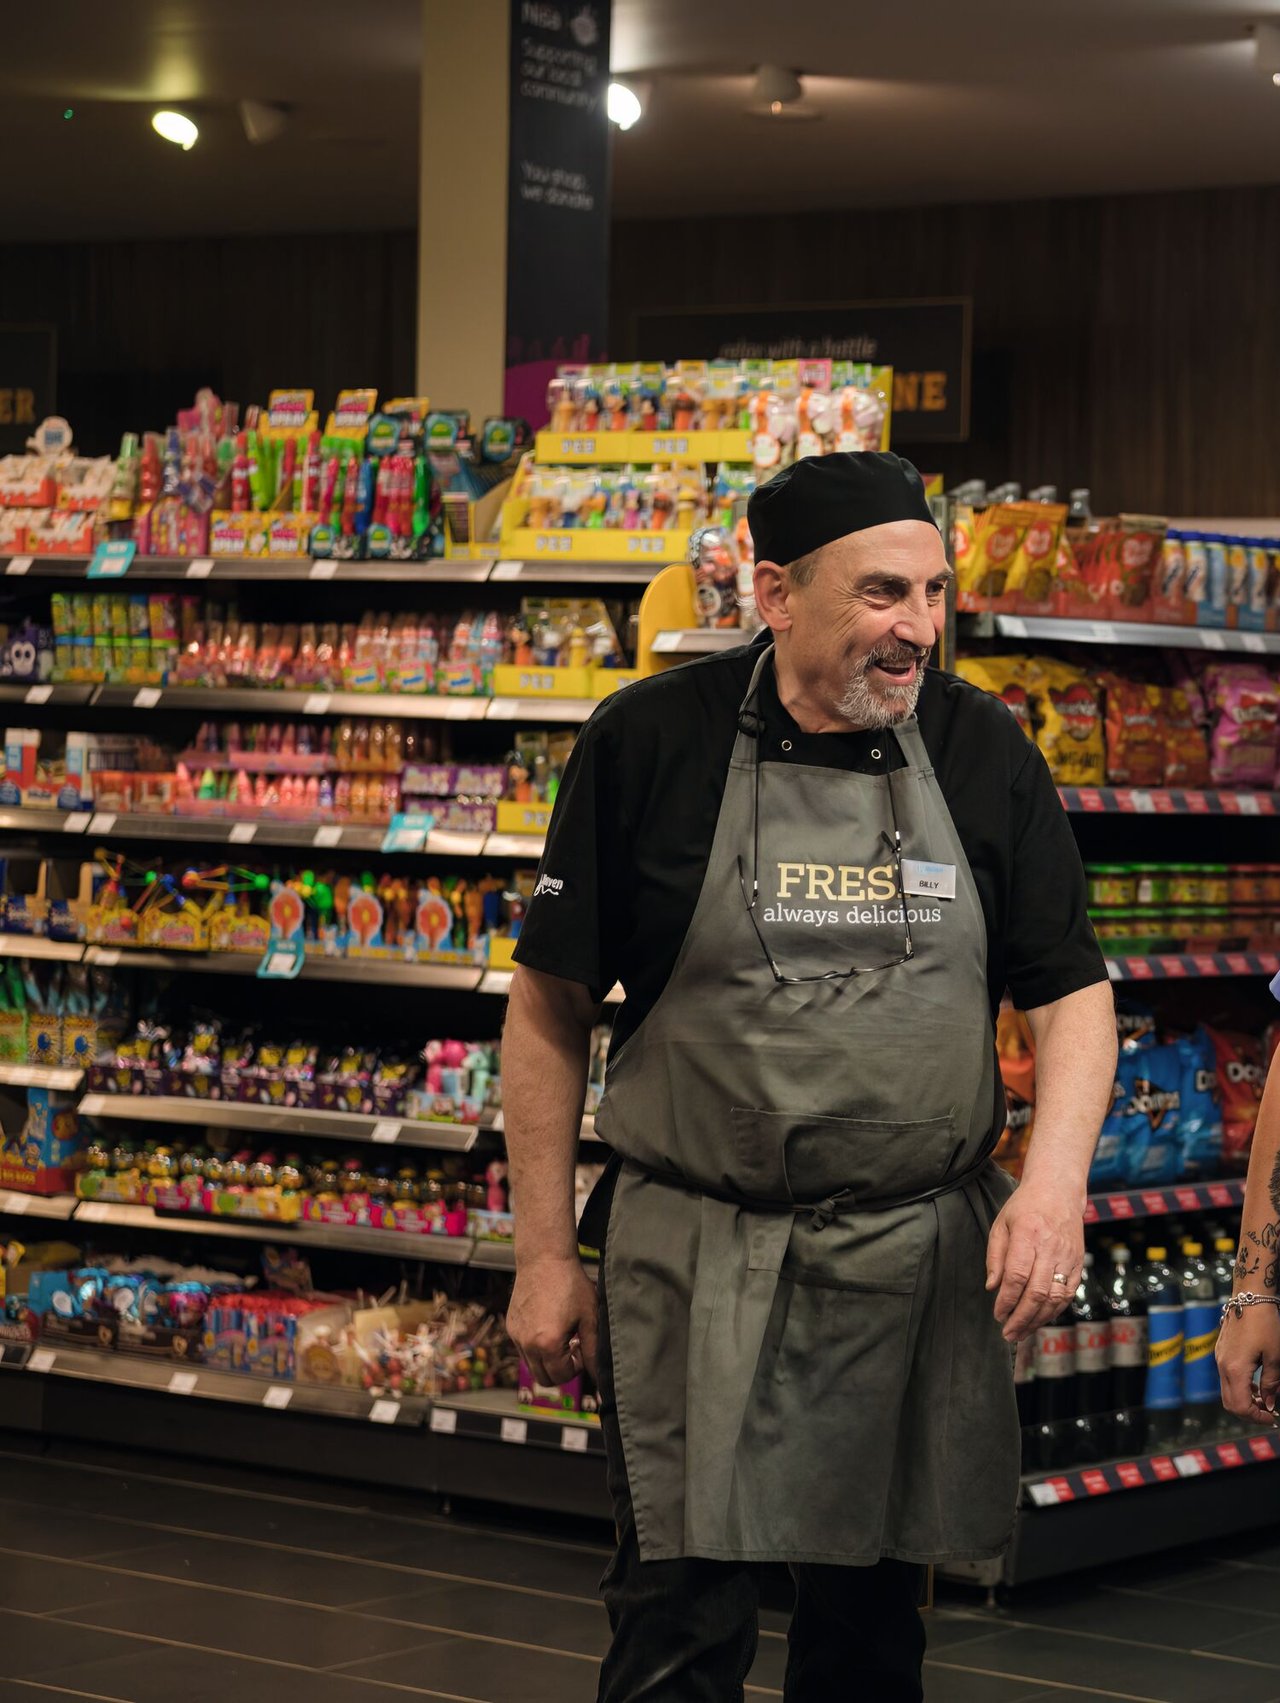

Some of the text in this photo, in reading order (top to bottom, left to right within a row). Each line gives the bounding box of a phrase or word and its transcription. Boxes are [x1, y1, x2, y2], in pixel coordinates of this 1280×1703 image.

[776, 862, 912, 902] FRES
[919, 880, 939, 889] BILLY
[763, 902, 941, 927] always delicious
